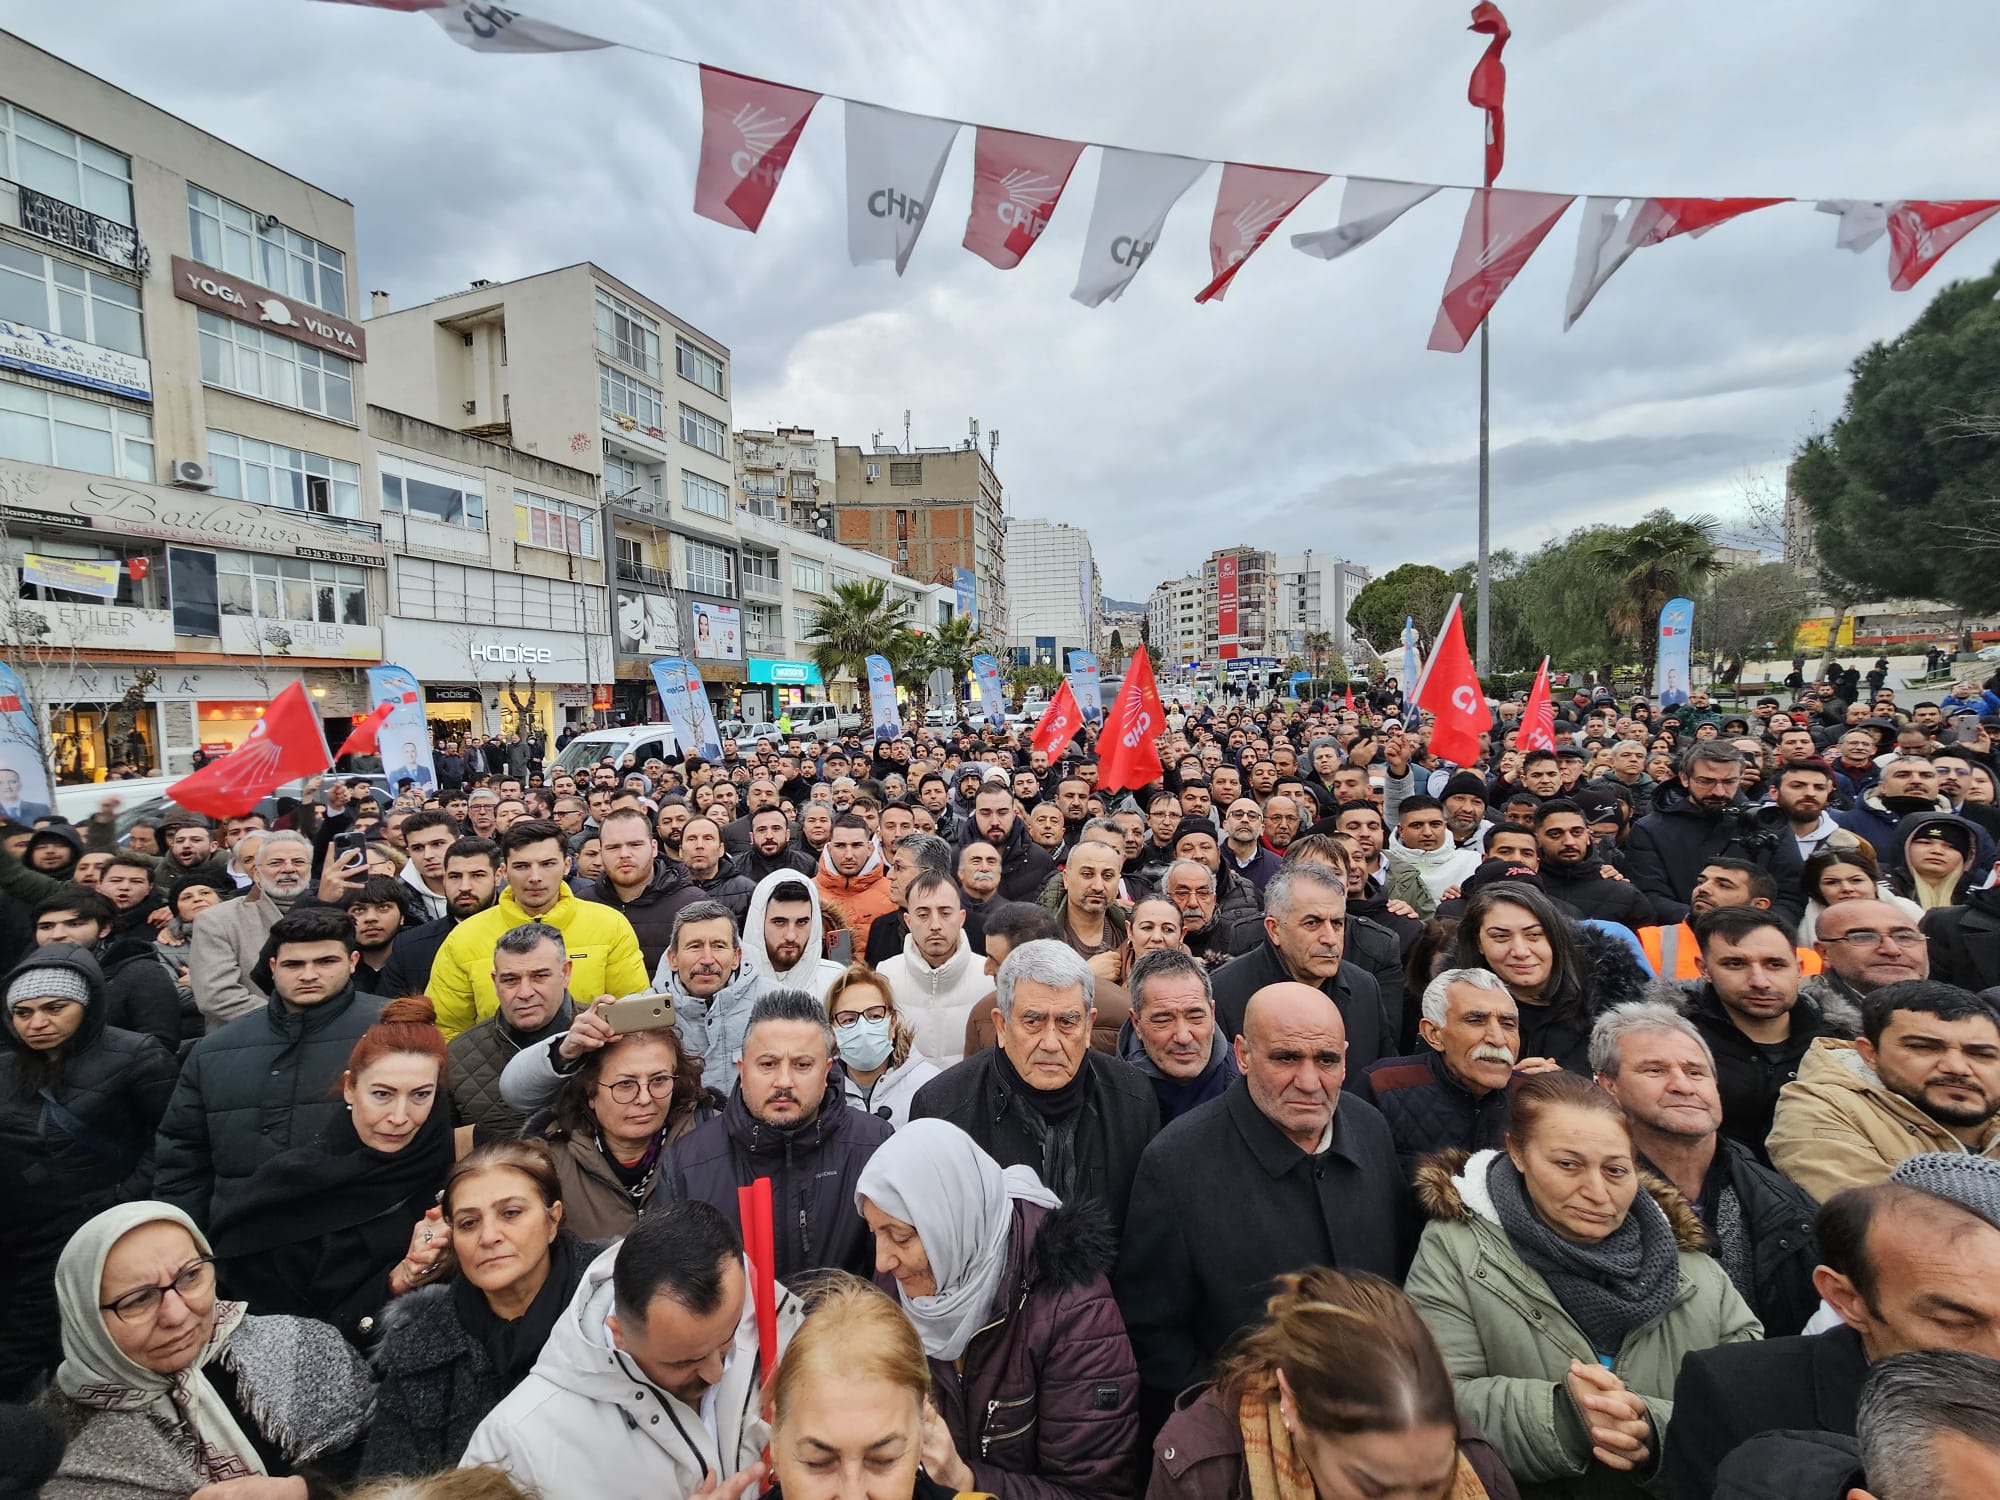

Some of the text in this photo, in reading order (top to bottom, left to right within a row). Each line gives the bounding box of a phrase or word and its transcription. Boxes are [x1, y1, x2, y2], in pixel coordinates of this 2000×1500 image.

[463, 2, 521, 38] CH
[868, 188, 926, 227] CHP
[1110, 236, 1154, 269] CH
[186, 272, 247, 309] YOGA
[1, 507, 84, 526] lamos.com.tr
[70, 482, 302, 545] Bailamos
